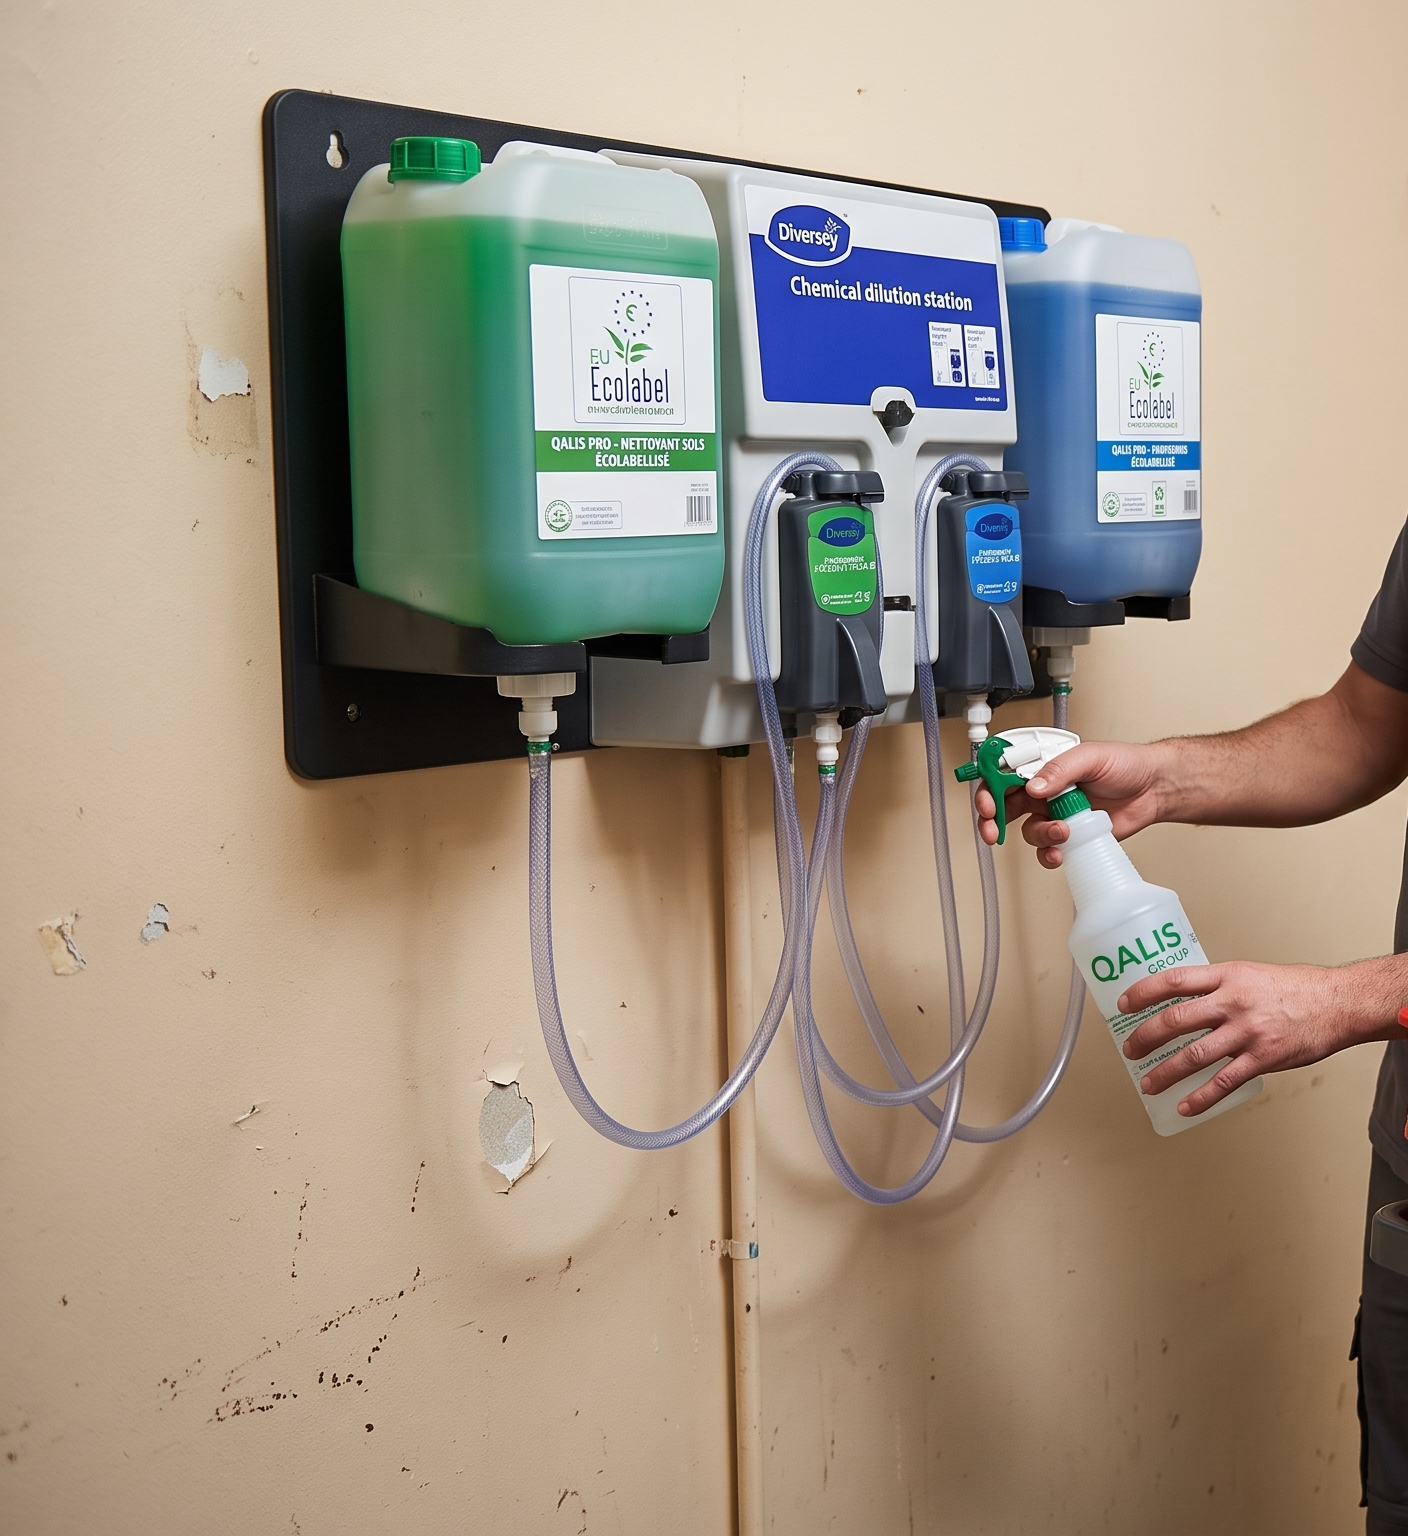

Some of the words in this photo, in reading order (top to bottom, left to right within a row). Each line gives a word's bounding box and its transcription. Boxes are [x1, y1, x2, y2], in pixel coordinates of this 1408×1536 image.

[778, 222, 839, 252] Diversey
[790, 275, 861, 301] Chemical
[864, 282, 922, 307] dilution
[924, 290, 973, 312] station
[590, 348, 610, 364] EU
[591, 366, 669, 403] Ecolabel
[1129, 378, 1140, 390] EU
[1130, 391, 1174, 419] Ecolabel
[551, 436, 586, 451] QALIS
[588, 437, 611, 450] PRO
[620, 437, 680, 450] NETTOYANT
[682, 438, 705, 451] SOLS
[595, 451, 670, 468] ÉCOLABELLISÉ
[1091, 922, 1182, 982] QALIS
[1148, 948, 1189, 975] GROUP
